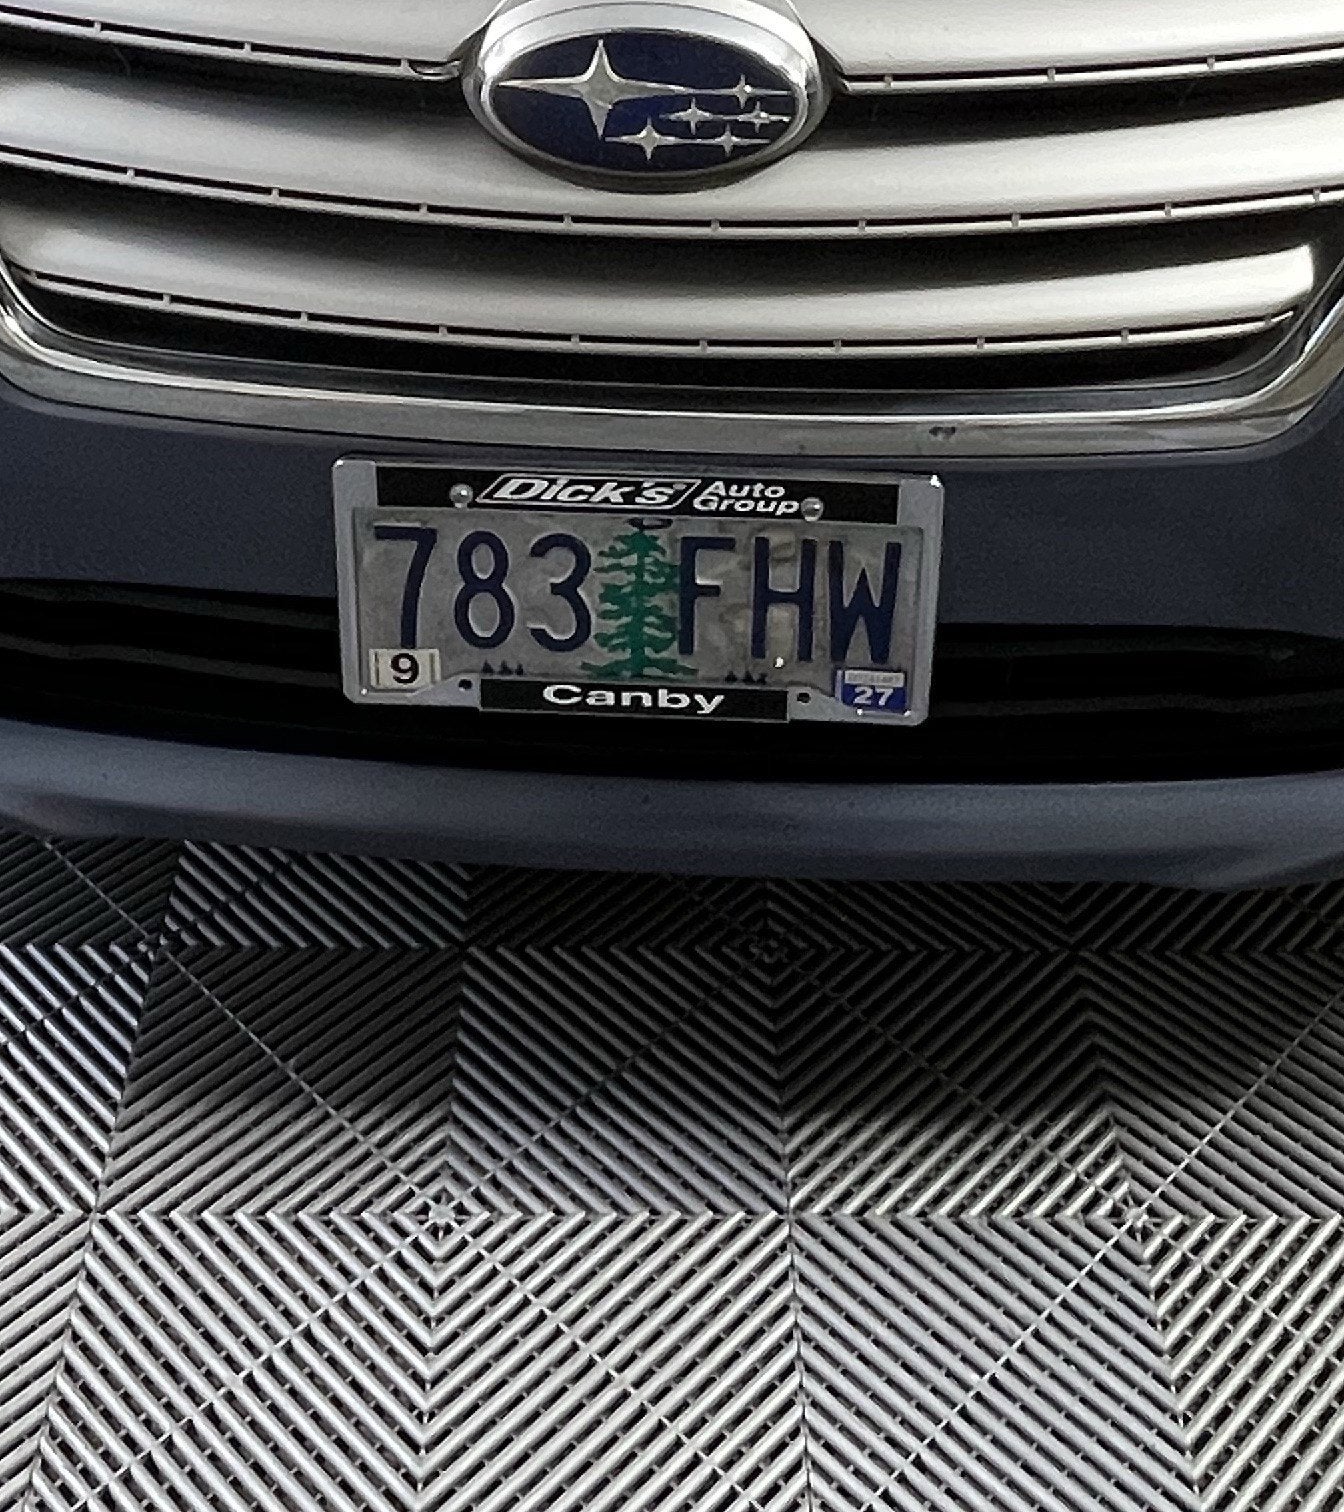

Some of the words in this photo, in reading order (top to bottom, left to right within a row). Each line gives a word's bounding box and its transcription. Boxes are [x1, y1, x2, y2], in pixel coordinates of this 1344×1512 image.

[493, 477, 676, 505] Dick's
[703, 480, 786, 498] Auto
[693, 496, 800, 515] Group
[373, 525, 593, 652] 783
[677, 535, 902, 664] FHW
[390, 652, 420, 684] 9
[542, 684, 725, 715] Canby
[853, 686, 894, 706] 27
